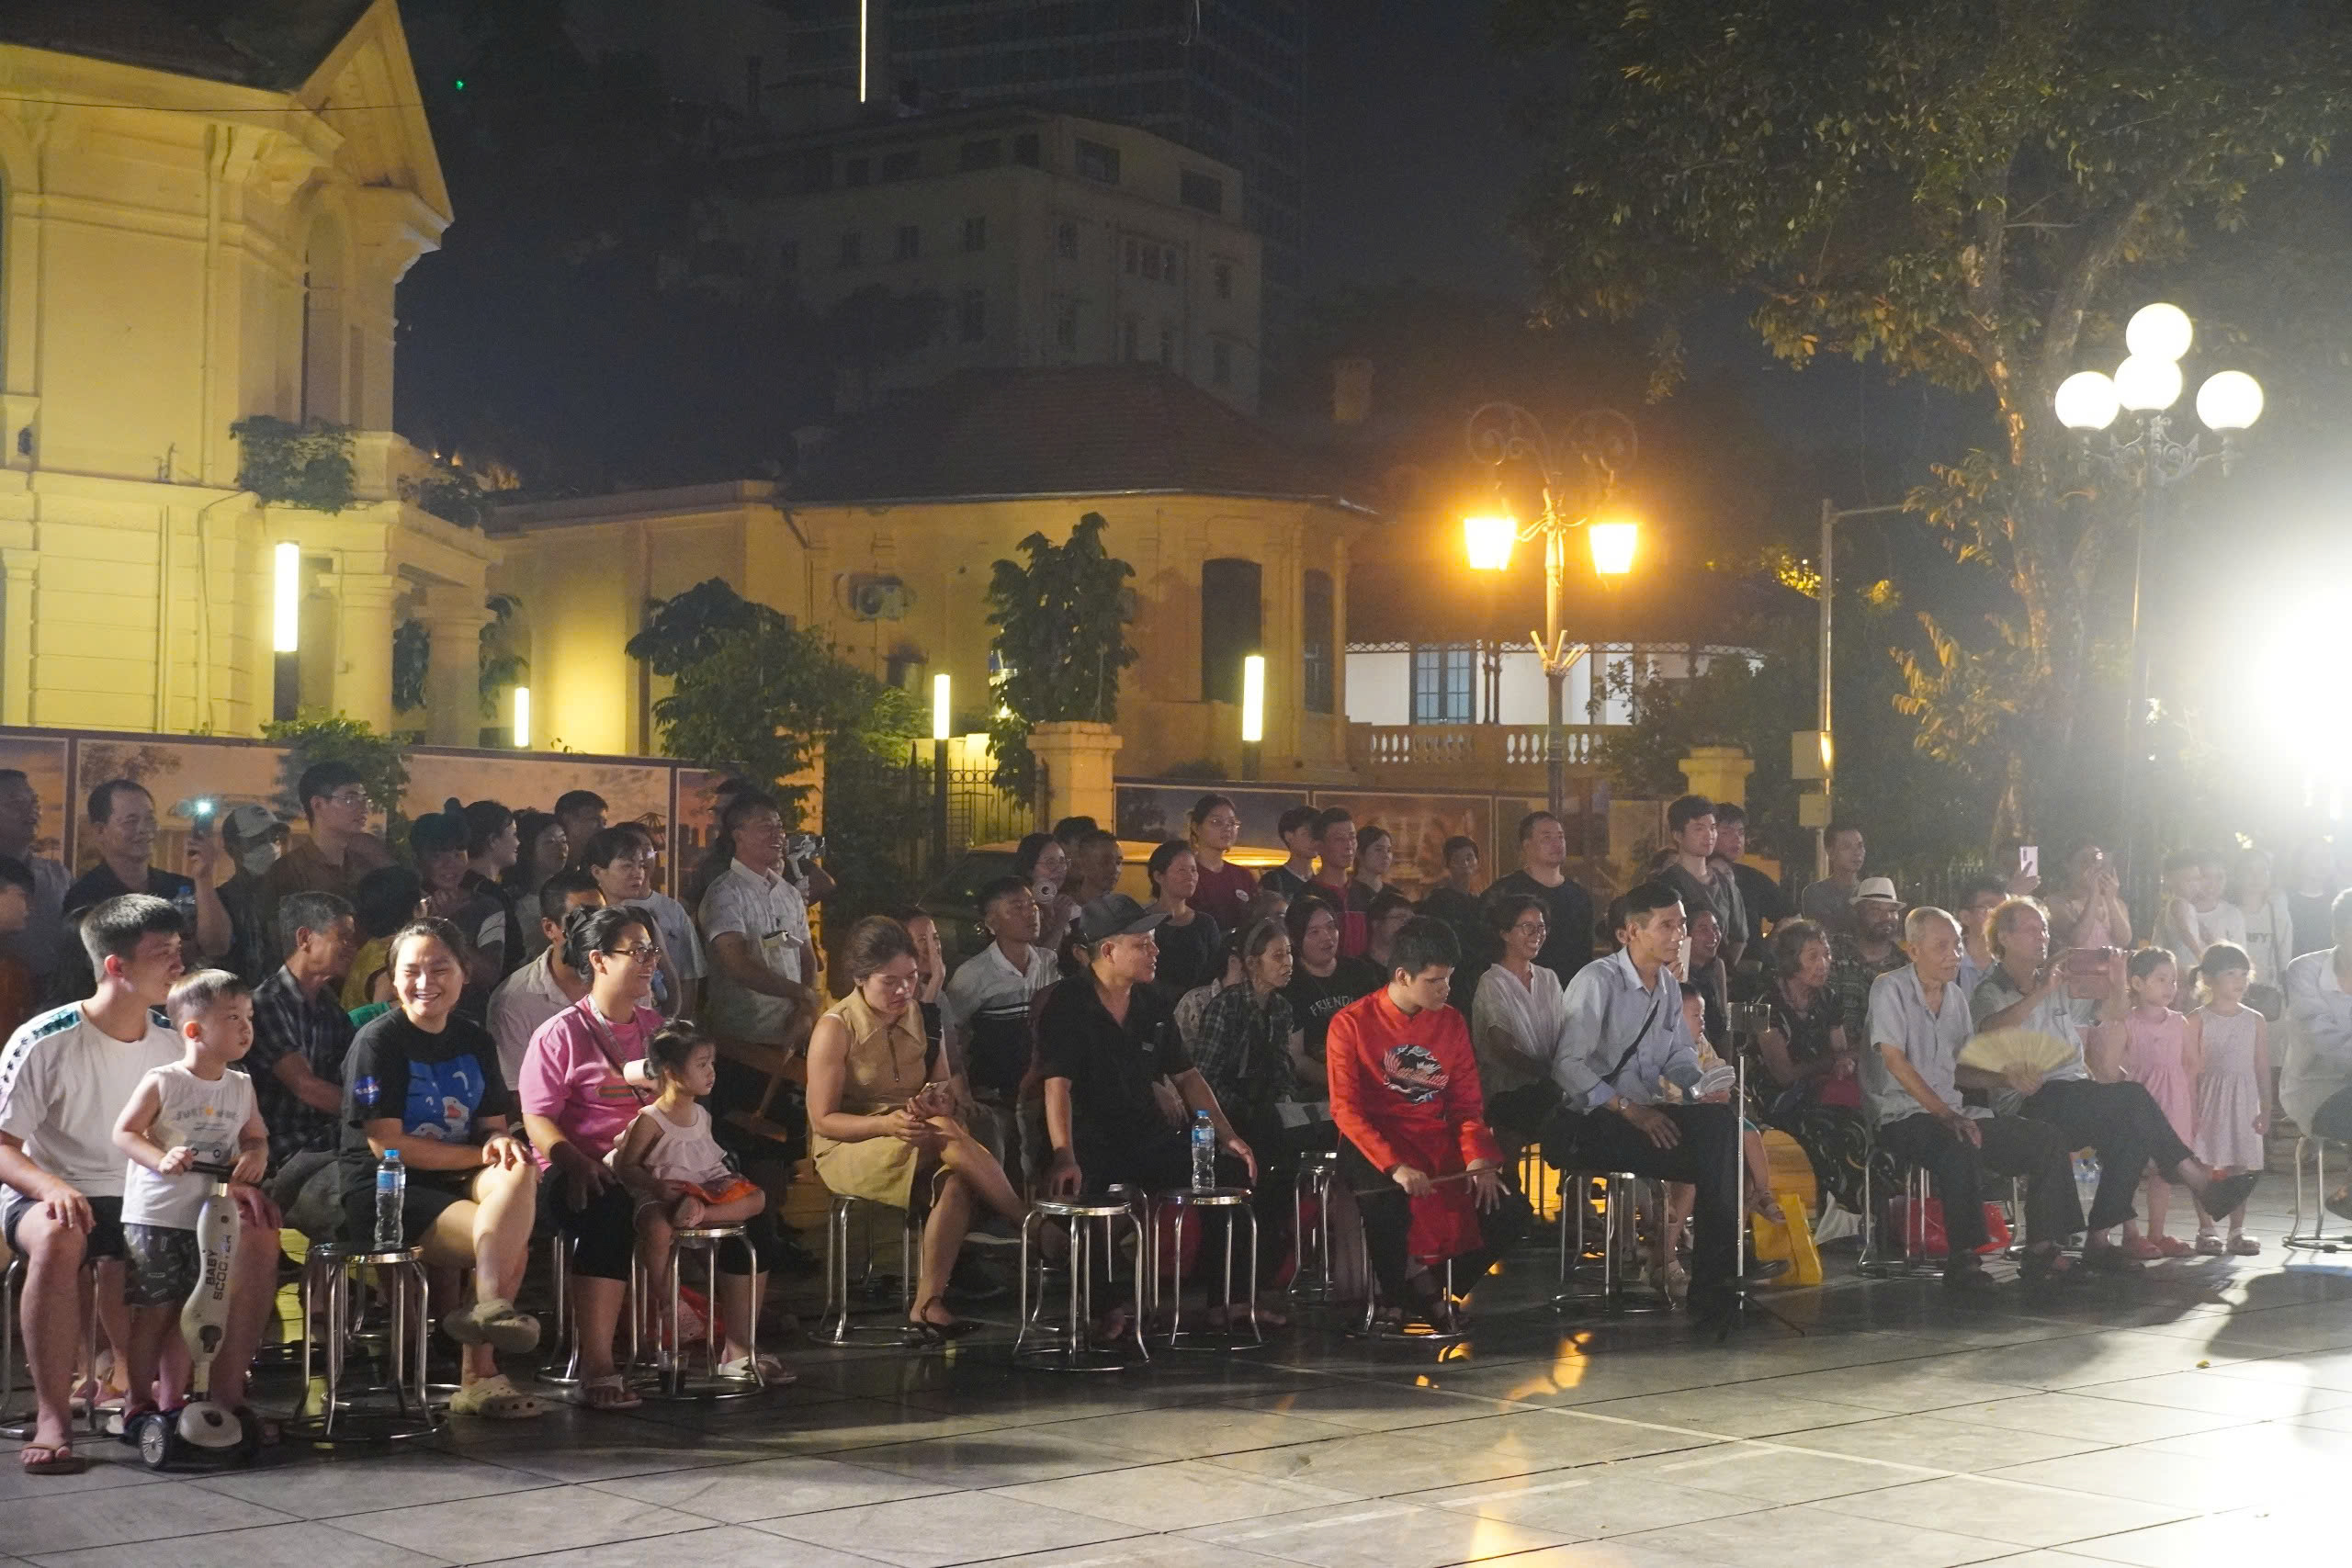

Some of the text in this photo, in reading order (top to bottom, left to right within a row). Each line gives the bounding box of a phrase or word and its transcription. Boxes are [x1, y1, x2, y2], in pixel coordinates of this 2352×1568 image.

[1309, 996, 1353, 1017] FRIEND
[205, 1249, 218, 1286] BABY
[213, 1235, 232, 1301] SCOO
